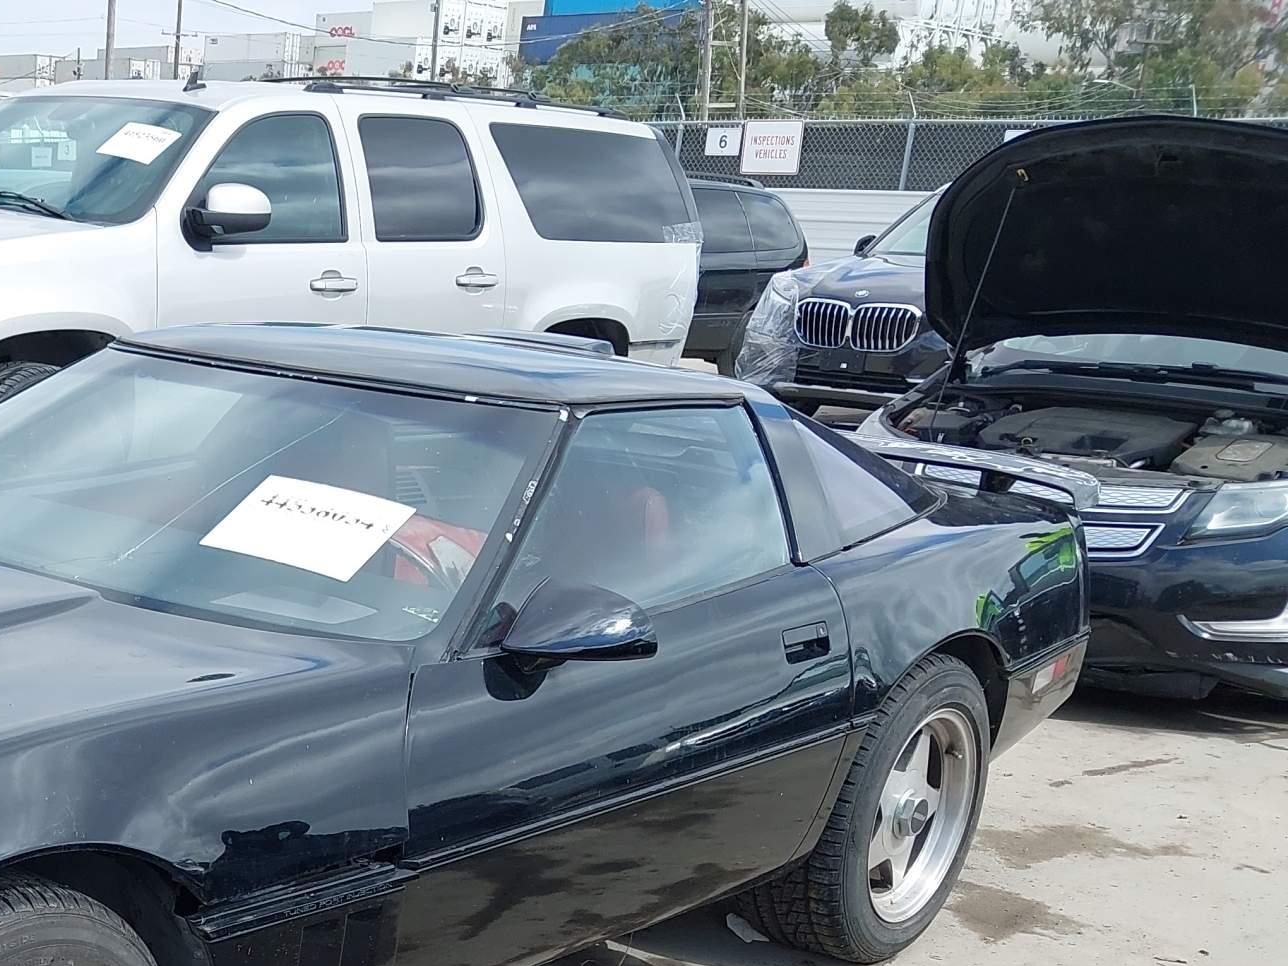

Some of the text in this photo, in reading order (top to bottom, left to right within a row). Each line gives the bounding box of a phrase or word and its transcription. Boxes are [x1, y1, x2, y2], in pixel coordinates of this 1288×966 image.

[328, 26, 355, 38] OOCL
[719, 135, 728, 149] 6
[750, 136, 795, 146] INSPECTIONS
[754, 149, 788, 160] VEHICLES
